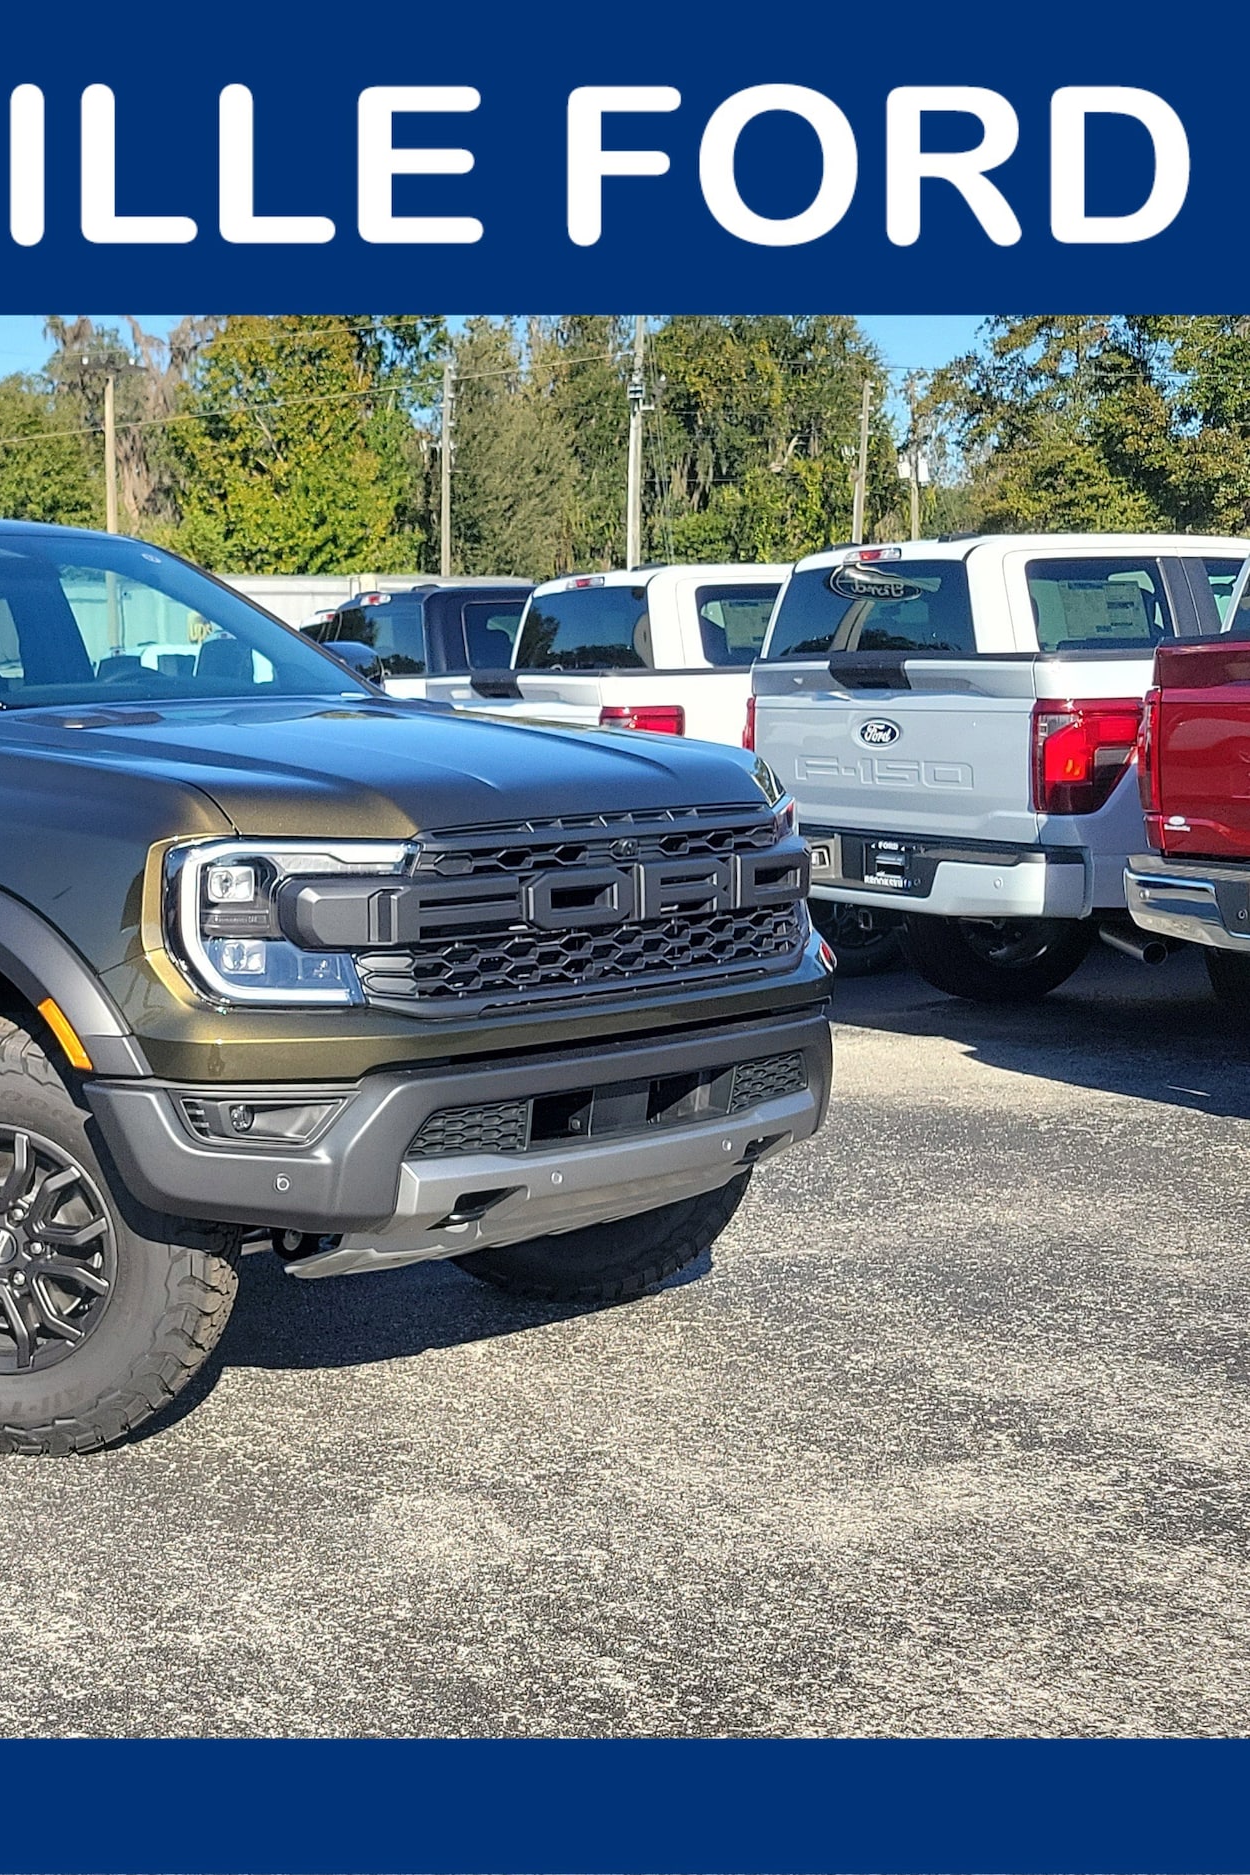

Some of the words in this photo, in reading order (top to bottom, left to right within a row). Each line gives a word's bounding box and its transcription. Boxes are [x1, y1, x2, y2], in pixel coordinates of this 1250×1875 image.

[862, 723, 892, 743] Ford
[795, 755, 975, 791] F-150
[878, 840, 899, 851] FORD
[367, 850, 812, 946] FORD
